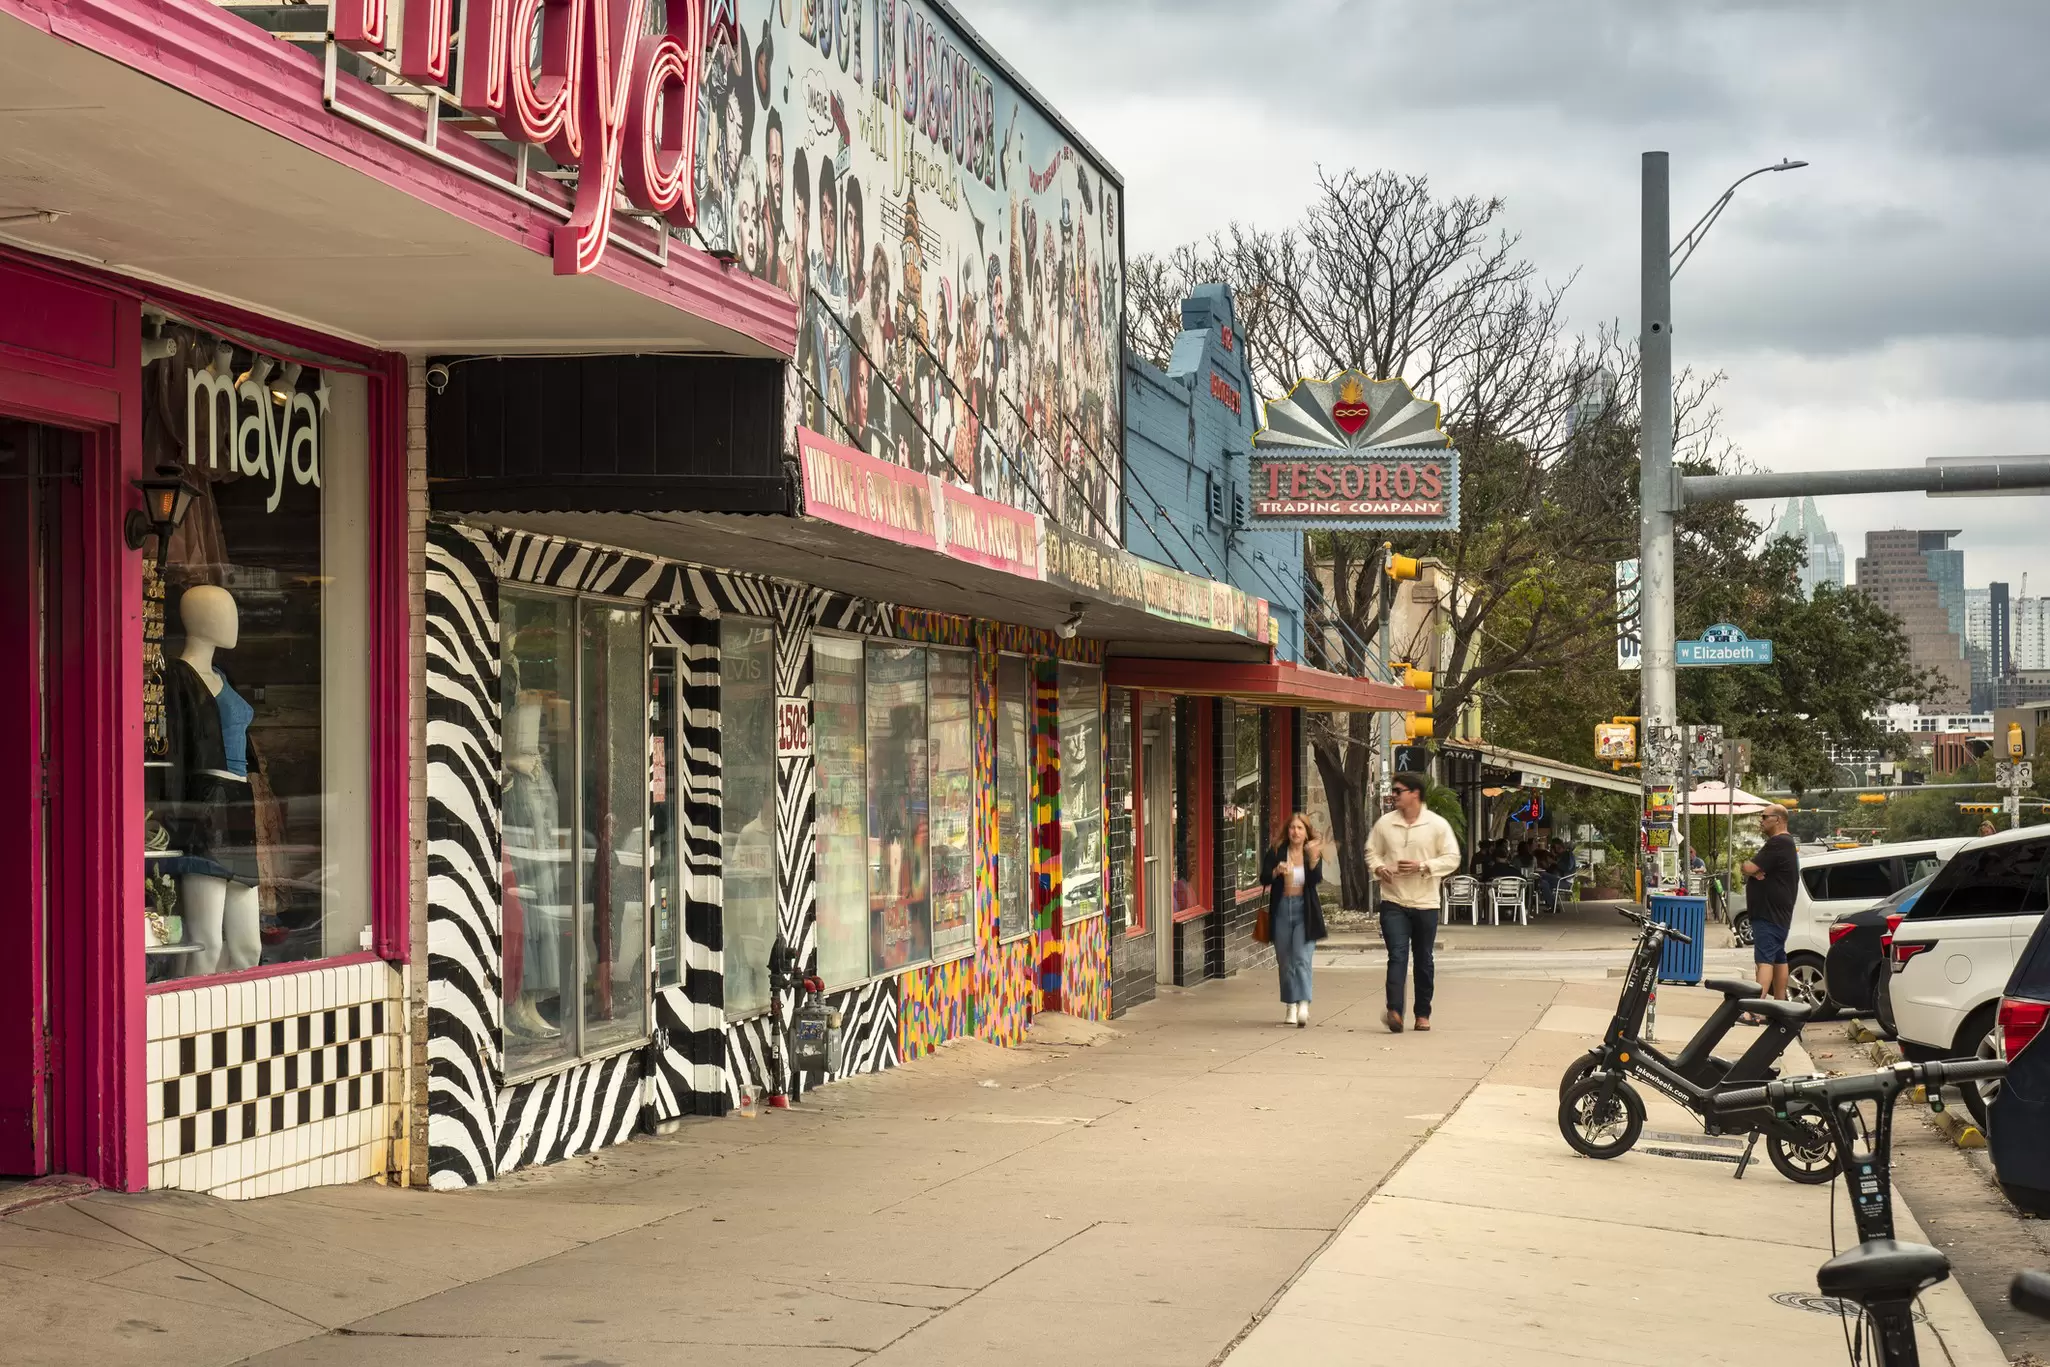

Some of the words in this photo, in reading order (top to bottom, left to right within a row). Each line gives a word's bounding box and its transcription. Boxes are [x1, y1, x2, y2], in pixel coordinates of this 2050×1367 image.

[902, 0, 996, 191] DISGUISE
[187, 368, 322, 513] maya
[804, 445, 857, 514] VINTAGE
[1261, 463, 1443, 500] TESOROS
[1259, 502, 1341, 513] TRADING
[1349, 502, 1440, 513] COMPANY
[1682, 648, 1690, 657] W
[1694, 646, 1754, 659] Elizabeth
[779, 704, 807, 750] 1506
[1444, 750, 1475, 761] ATM
[1635, 1065, 1690, 1101] takewheels.com
